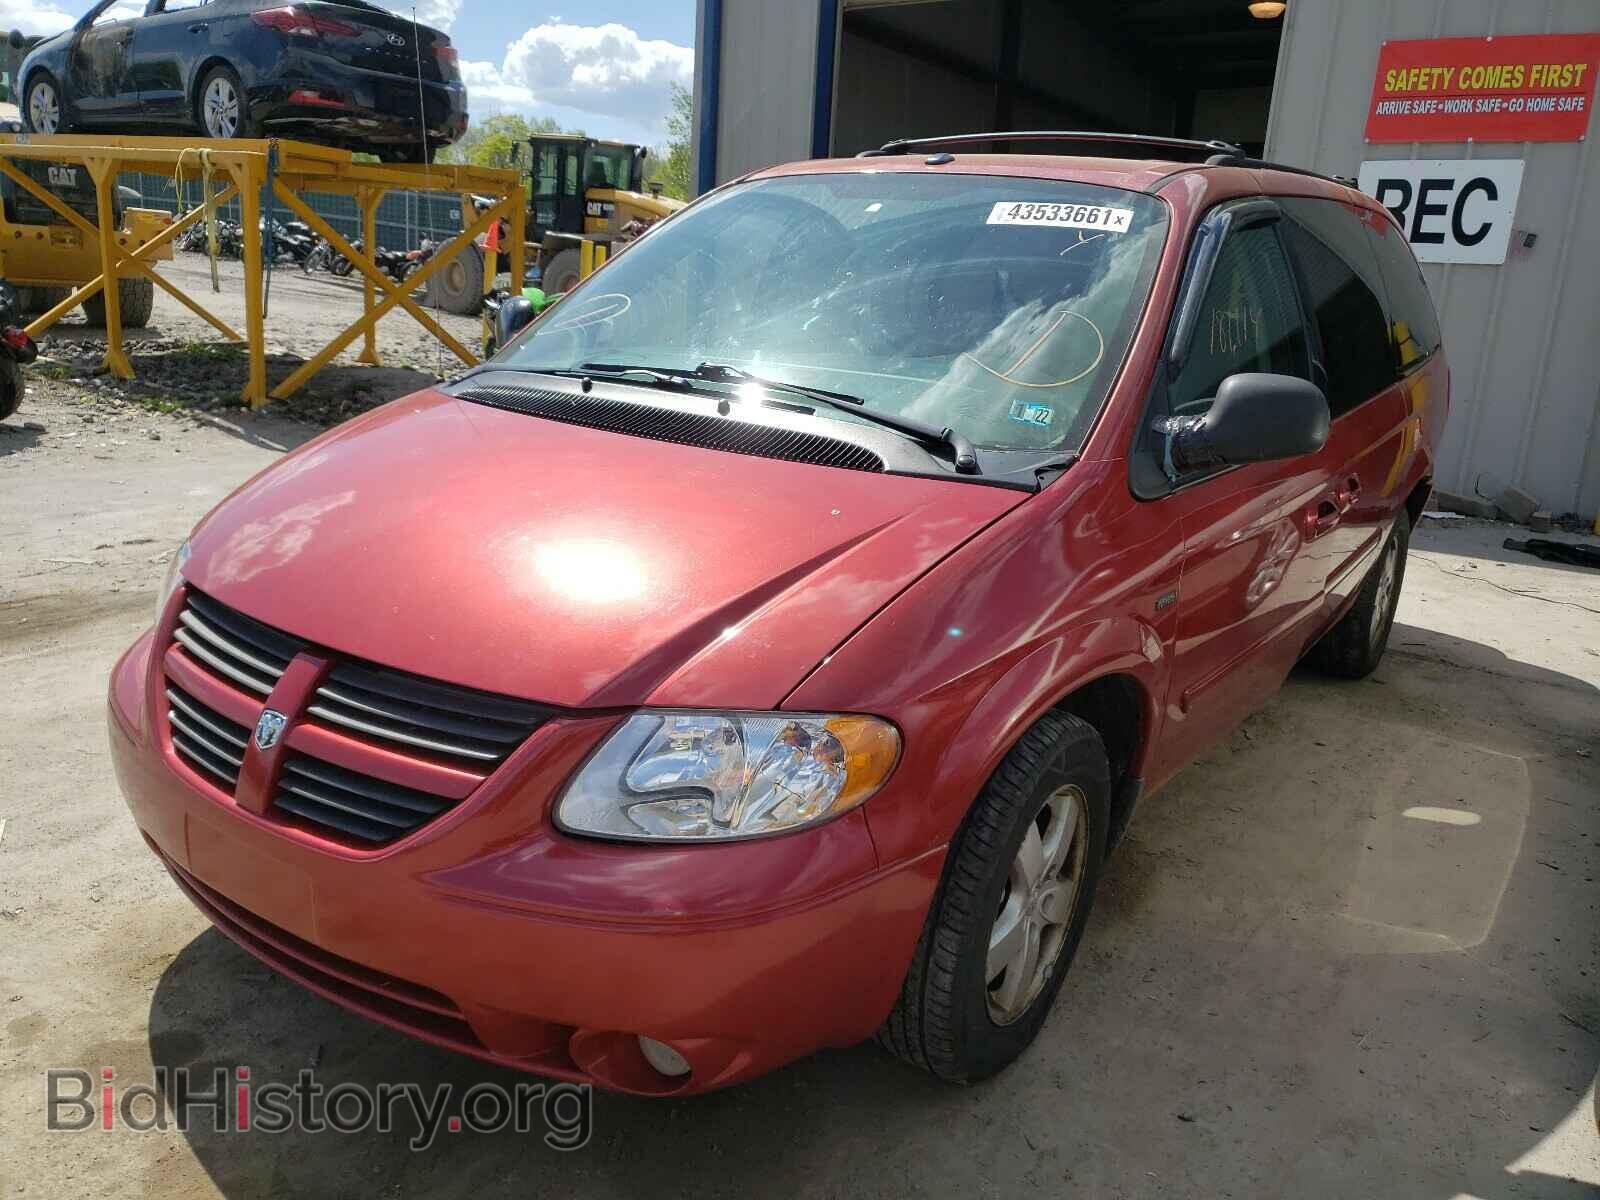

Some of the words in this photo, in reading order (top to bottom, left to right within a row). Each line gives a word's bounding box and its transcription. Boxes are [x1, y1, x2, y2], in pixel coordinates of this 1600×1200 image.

[1384, 67, 1455, 92] SAFETY
[1458, 64, 1525, 89] COMES
[1529, 63, 1587, 88] FIRST
[1375, 100, 1412, 115] ARRIVE
[1412, 99, 1438, 114] SAFE
[1443, 99, 1473, 113] WORK
[1475, 98, 1501, 112] SAFE
[1508, 98, 1524, 112] GO
[1526, 97, 1557, 111] HOME
[1558, 96, 1585, 111] SAFE
[48, 167, 77, 186] CAT
[587, 201, 602, 216] CAT
[1007, 203, 1113, 226] 43533661
[1034, 408, 1050, 425] 22
